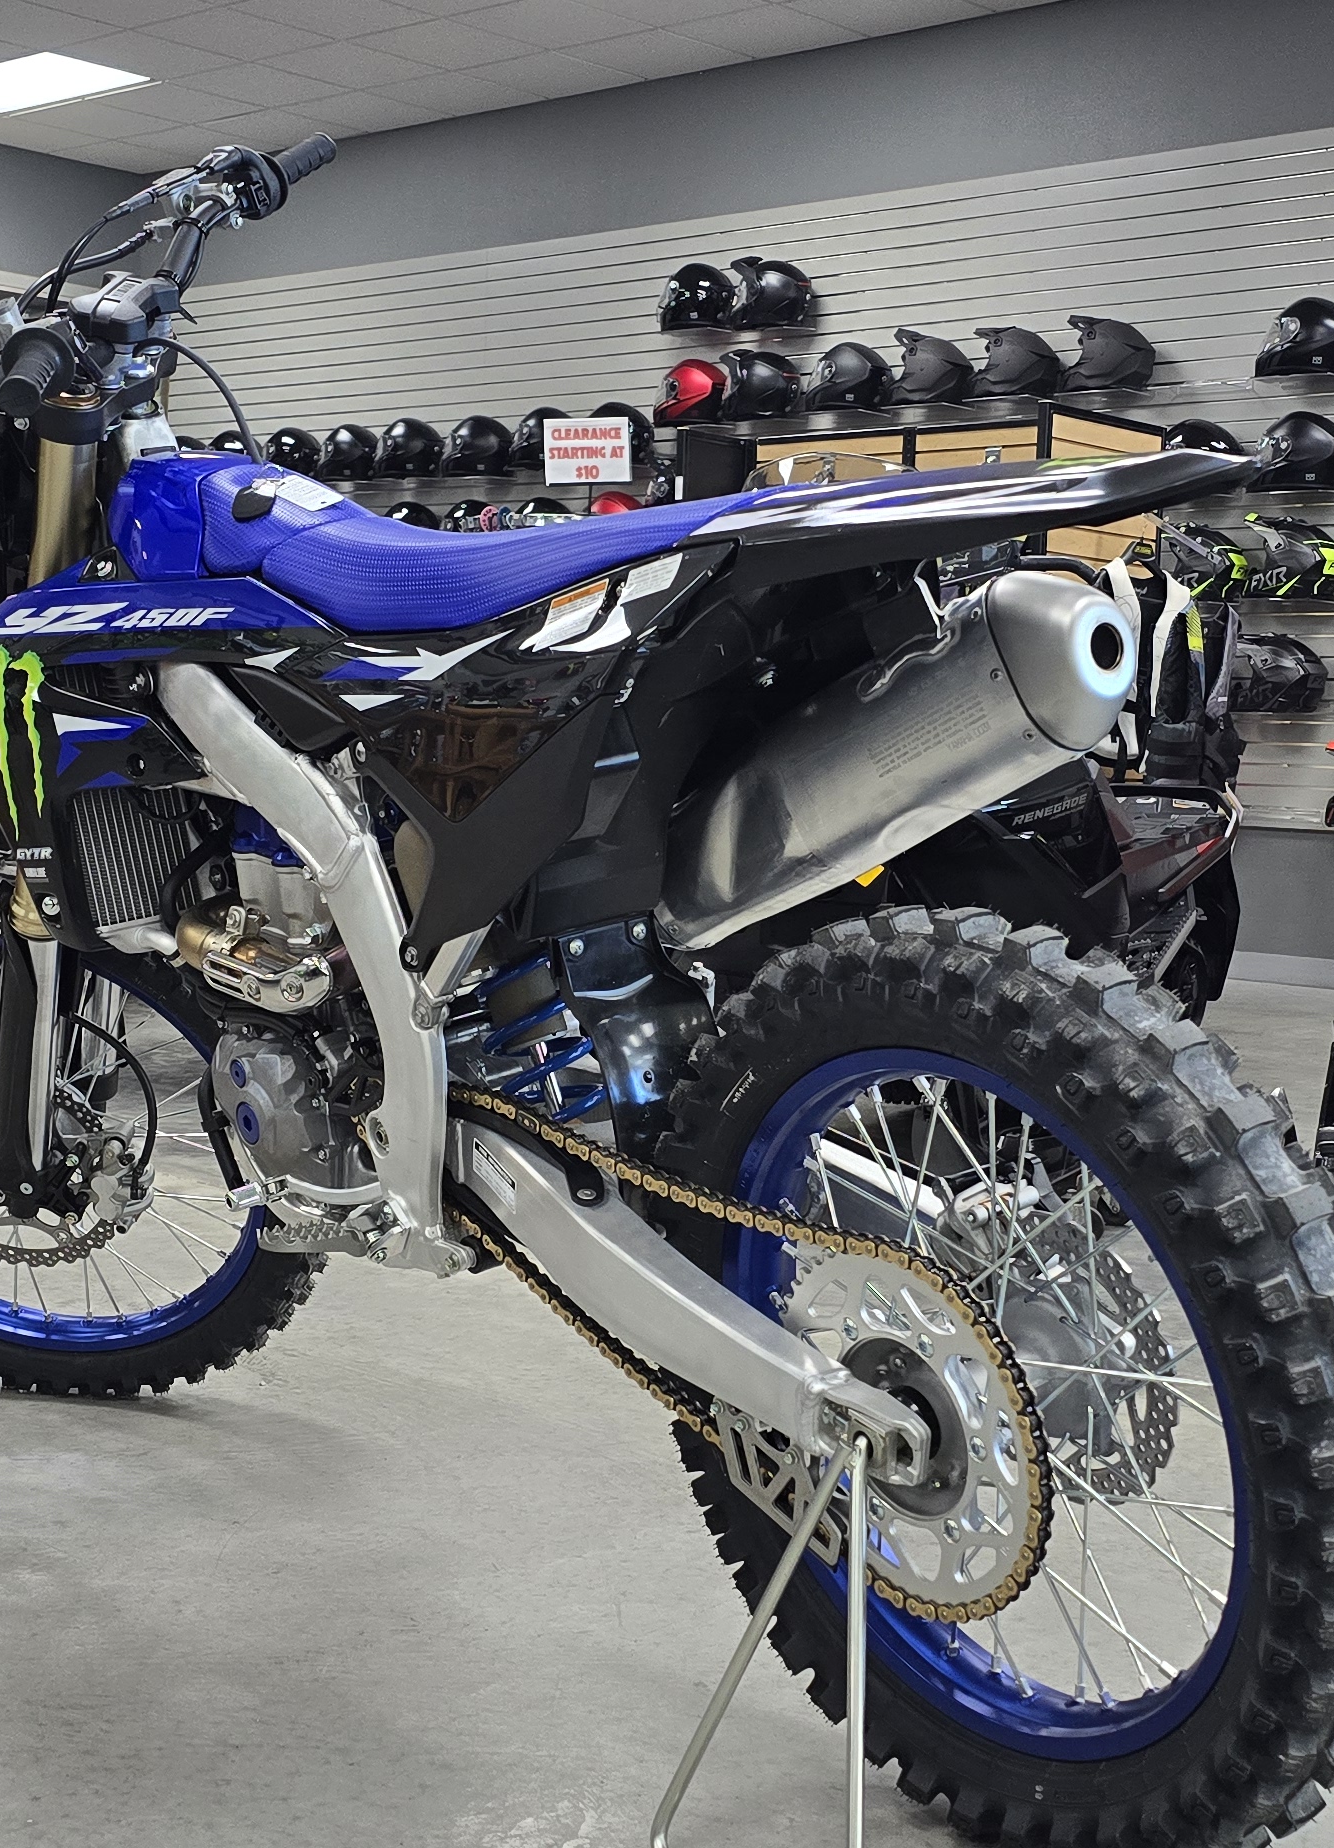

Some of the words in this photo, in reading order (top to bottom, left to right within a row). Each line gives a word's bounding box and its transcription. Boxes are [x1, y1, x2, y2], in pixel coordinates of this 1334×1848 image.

[551, 427, 622, 441] CLEARANCE
[548, 446, 606, 460] STARTING
[609, 446, 625, 459] AT
[575, 465, 600, 480] $10
[1250, 566, 1287, 592] FXR
[110, 606, 236, 629] 450F
[1012, 793, 1088, 827] RENEGADE
[16, 846, 54, 861] GYTR
